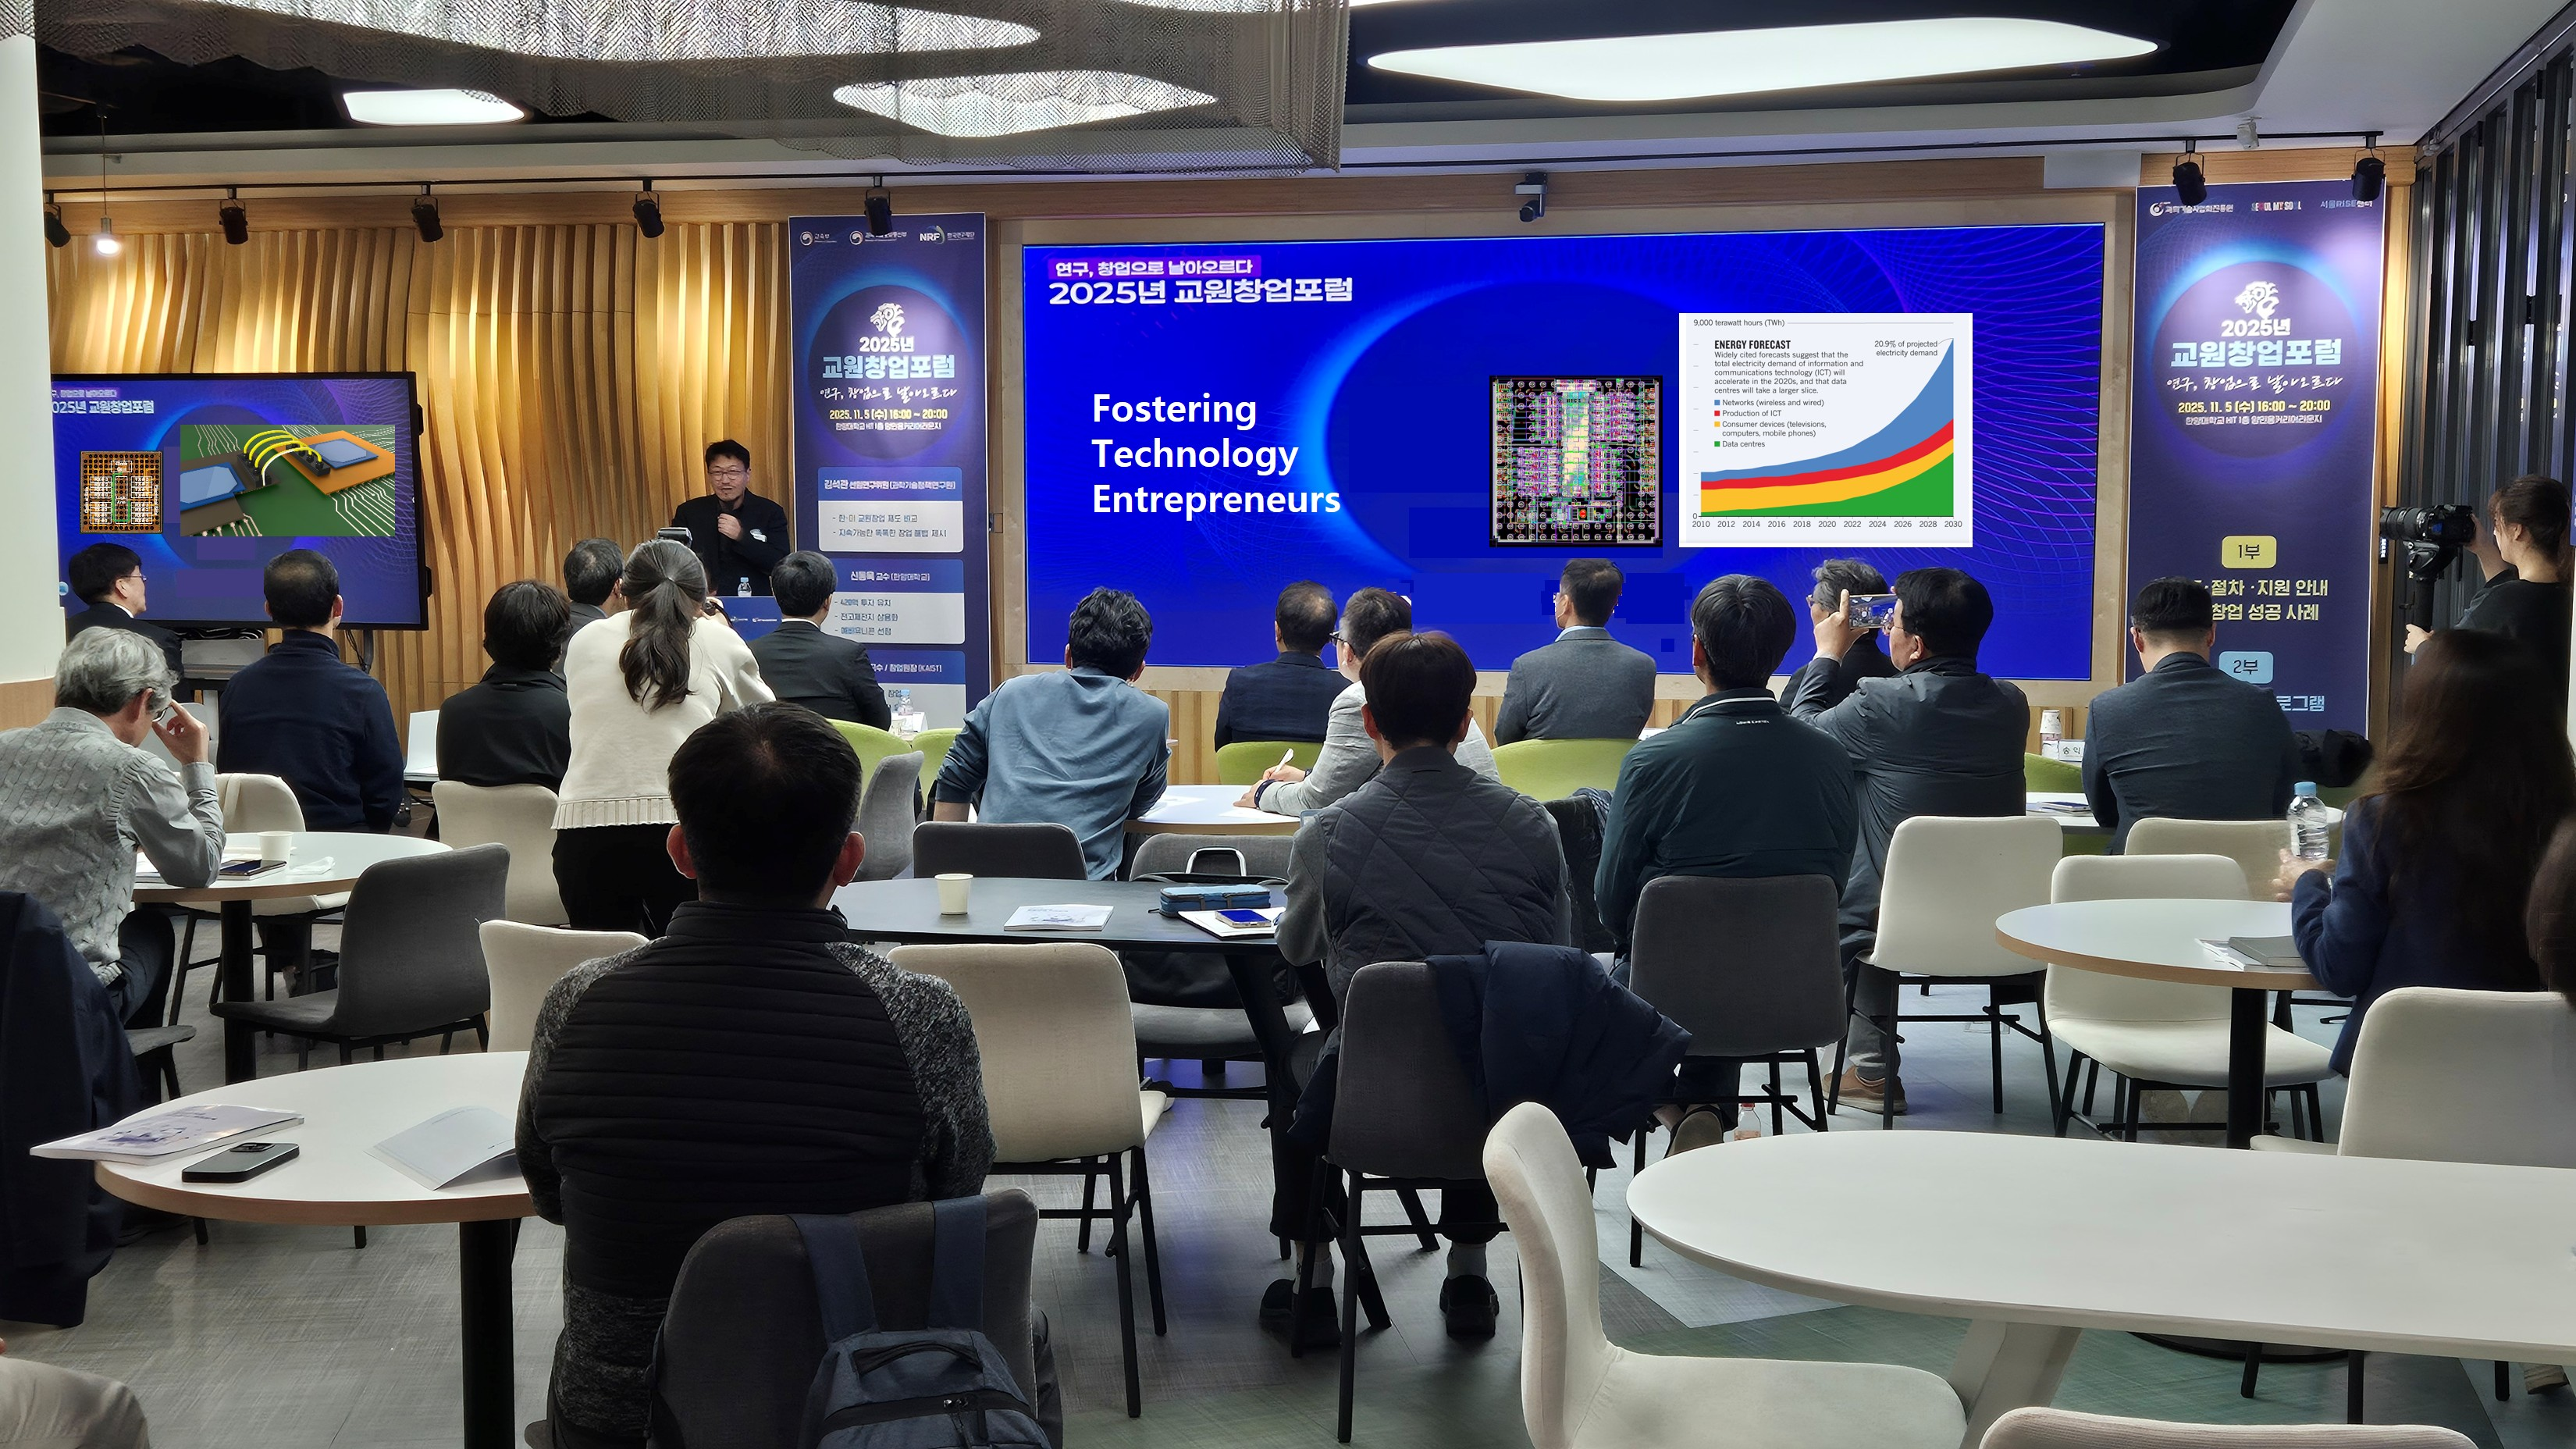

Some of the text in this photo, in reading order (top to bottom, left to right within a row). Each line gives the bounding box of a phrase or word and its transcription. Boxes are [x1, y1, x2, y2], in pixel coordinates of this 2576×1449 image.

[920, 233, 941, 241] NRF
[1055, 259, 1254, 278] 연구, 창업으로 날아오르다
[1049, 276, 1353, 305] 2025년 교원창업포럼
[1693, 319, 1713, 327] 9,000
[1764, 319, 1785, 328] (TWh)
[2221, 318, 2291, 337] 2025년
[859, 336, 915, 352] 2025년
[1714, 340, 1791, 350] ENERGY FORECAST
[1874, 340, 1897, 348] 20.9%
[1906, 340, 1938, 349] projected
[1714, 351, 1738, 360] Widely
[1791, 351, 1820, 360] suggest
[1876, 349, 1909, 358] electricity
[2171, 339, 2342, 368] 교원창업포럼
[822, 354, 955, 379] 교원창업포럼
[1731, 360, 1766, 368] electricity
[1774, 368, 1813, 378] technology
[1814, 368, 1832, 377] (ICT)
[1774, 377, 1799, 386] 2020s,
[2166, 374, 2343, 394] 연구, 창업으로 날아오르다
[820, 386, 844, 401] 연구,
[848, 386, 893, 401] 창업으로
[1778, 386, 1800, 395] larger
[52, 400, 155, 414] 025년 교원창업포럼
[1756, 399, 1786, 408] (wireless
[1802, 399, 1825, 408] wired)
[2178, 401, 2208, 413] 2025.
[2211, 401, 2222, 412] 11.
[2226, 401, 2232, 412] 5
[2258, 401, 2286, 412] 16:00
[2300, 400, 2331, 411] 20:00
[829, 409, 852, 420] 2025.
[864, 409, 870, 419] 5
[890, 408, 912, 420] 16:00
[922, 408, 948, 419] 20:00
[1094, 392, 1257, 431] Fostering
[1786, 421, 1827, 429] (televisions,
[2186, 416, 2225, 425] 한양대학교
[1721, 429, 1761, 438] computers,
[1788, 429, 1816, 438] phones)
[1091, 437, 1299, 476] Technology
[1094, 484, 1341, 522] Entrepreneurs
[2236, 544, 2261, 560] 1부
[2295, 579, 2329, 596] 안내
[2248, 603, 2282, 621] 성공
[2286, 603, 2319, 621] 사례
[2233, 659, 2259, 675] 2부
[2276, 695, 2325, 712] 로그램
